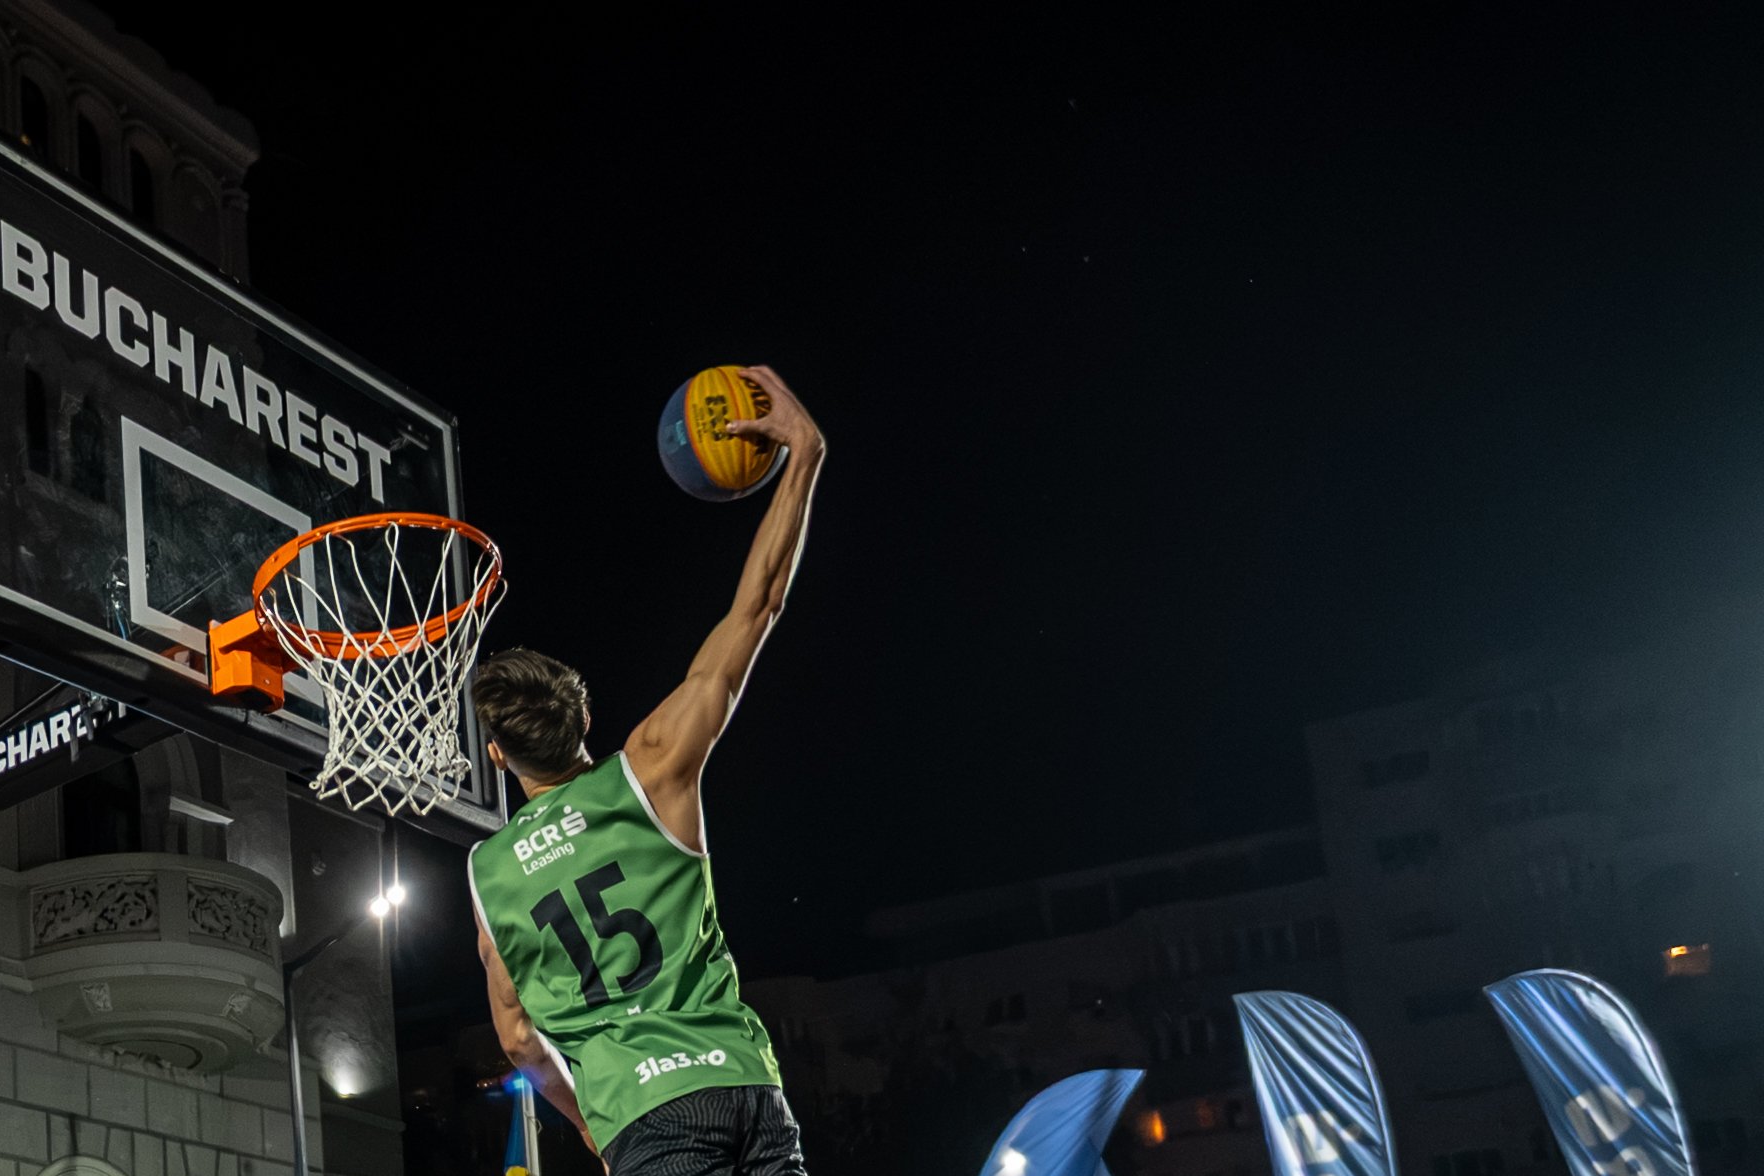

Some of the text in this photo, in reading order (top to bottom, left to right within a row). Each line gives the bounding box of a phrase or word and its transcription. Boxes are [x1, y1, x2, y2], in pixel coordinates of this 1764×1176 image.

[0, 219, 391, 505] BUCHAREST
[513, 823, 563, 862] BCR
[522, 841, 575, 876] Leasing
[530, 860, 663, 1008] 15
